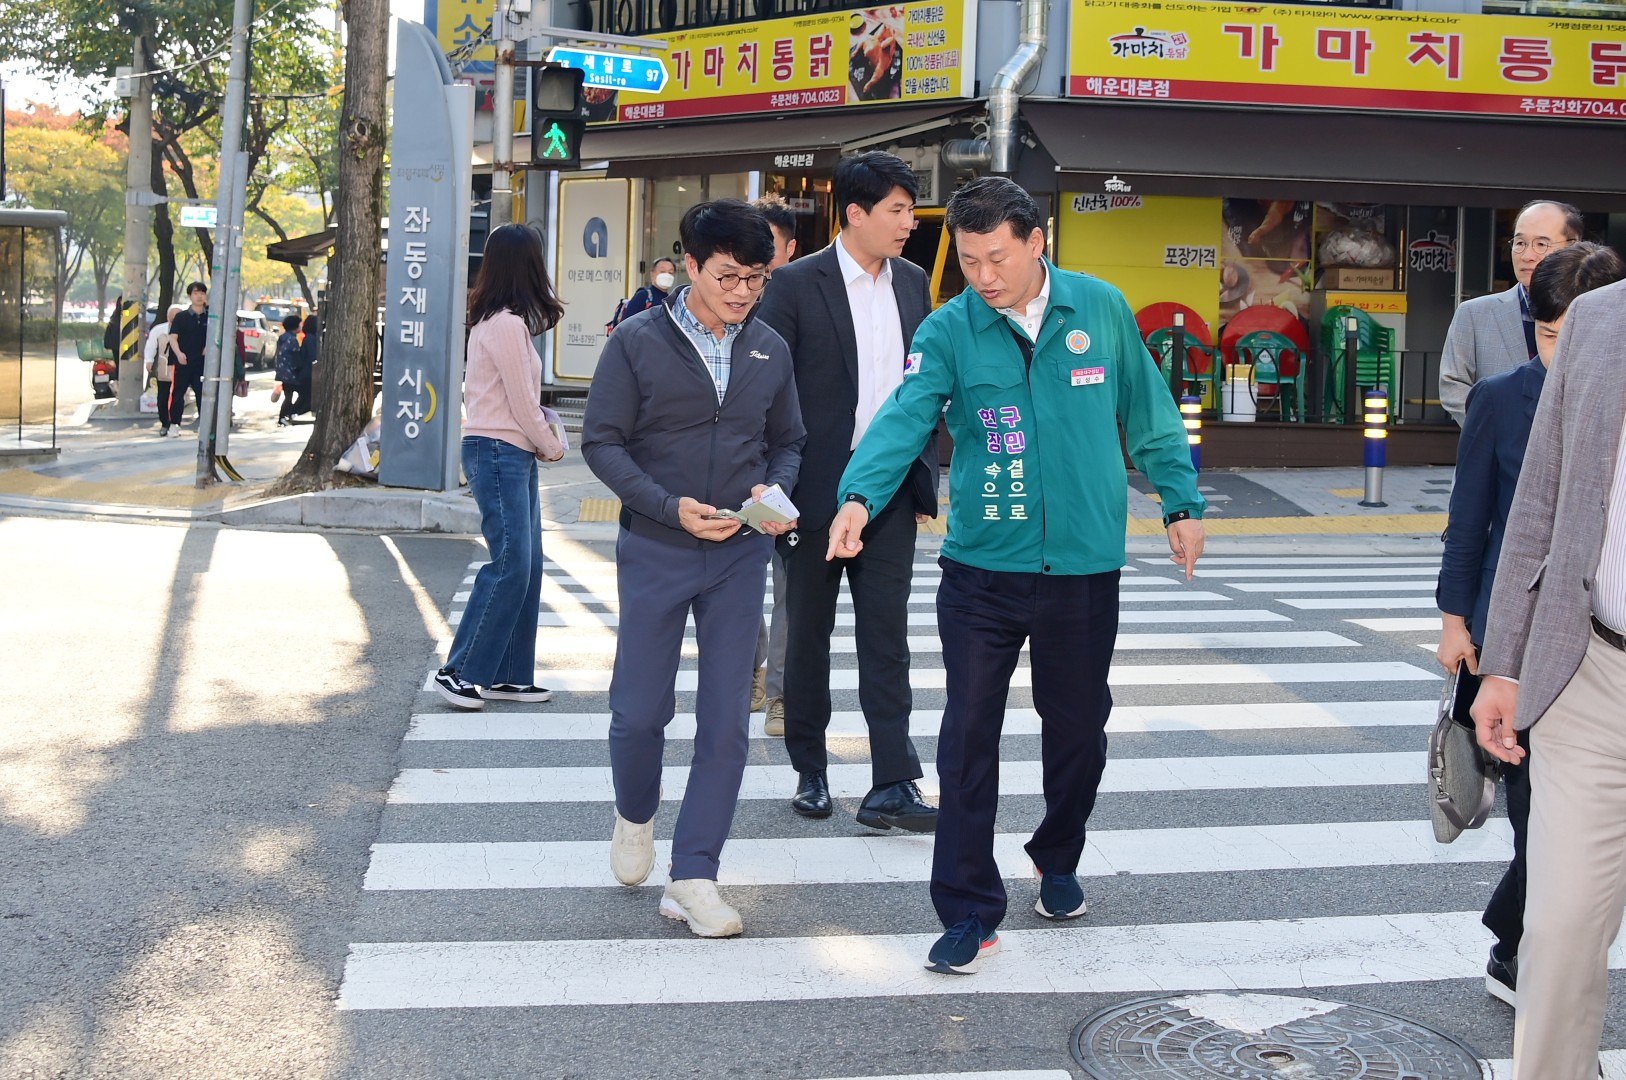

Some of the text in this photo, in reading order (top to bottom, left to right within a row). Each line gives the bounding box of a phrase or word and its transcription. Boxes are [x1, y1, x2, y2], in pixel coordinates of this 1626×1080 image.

[907, 5, 944, 25] 가마치통닭은
[1119, 1, 1162, 11] 대중화를
[1165, 3, 1208, 13] 선도하는
[1211, 6, 1232, 14] 기업
[1339, 13, 1461, 25] www.gamachi.co.kr
[907, 29, 946, 48] 국내산 신선육
[1111, 41, 1164, 59] 가마치
[583, 55, 633, 74] 세실로
[646, 69, 659, 82] 97
[589, 73, 626, 87] Sesil-ro
[1085, 77, 1170, 98] 해운대본점
[770, 89, 840, 107] 주문전화 704.0823
[625, 103, 665, 120] 해운대본점
[774, 153, 815, 168] 해운대본점
[1073, 195, 1141, 212] 신선육 100%
[1165, 246, 1216, 268] 포장가격
[1412, 248, 1449, 270] 가마치
[977, 407, 1002, 521] 현장 속으로
[999, 405, 1029, 521] 구민 곁으로
